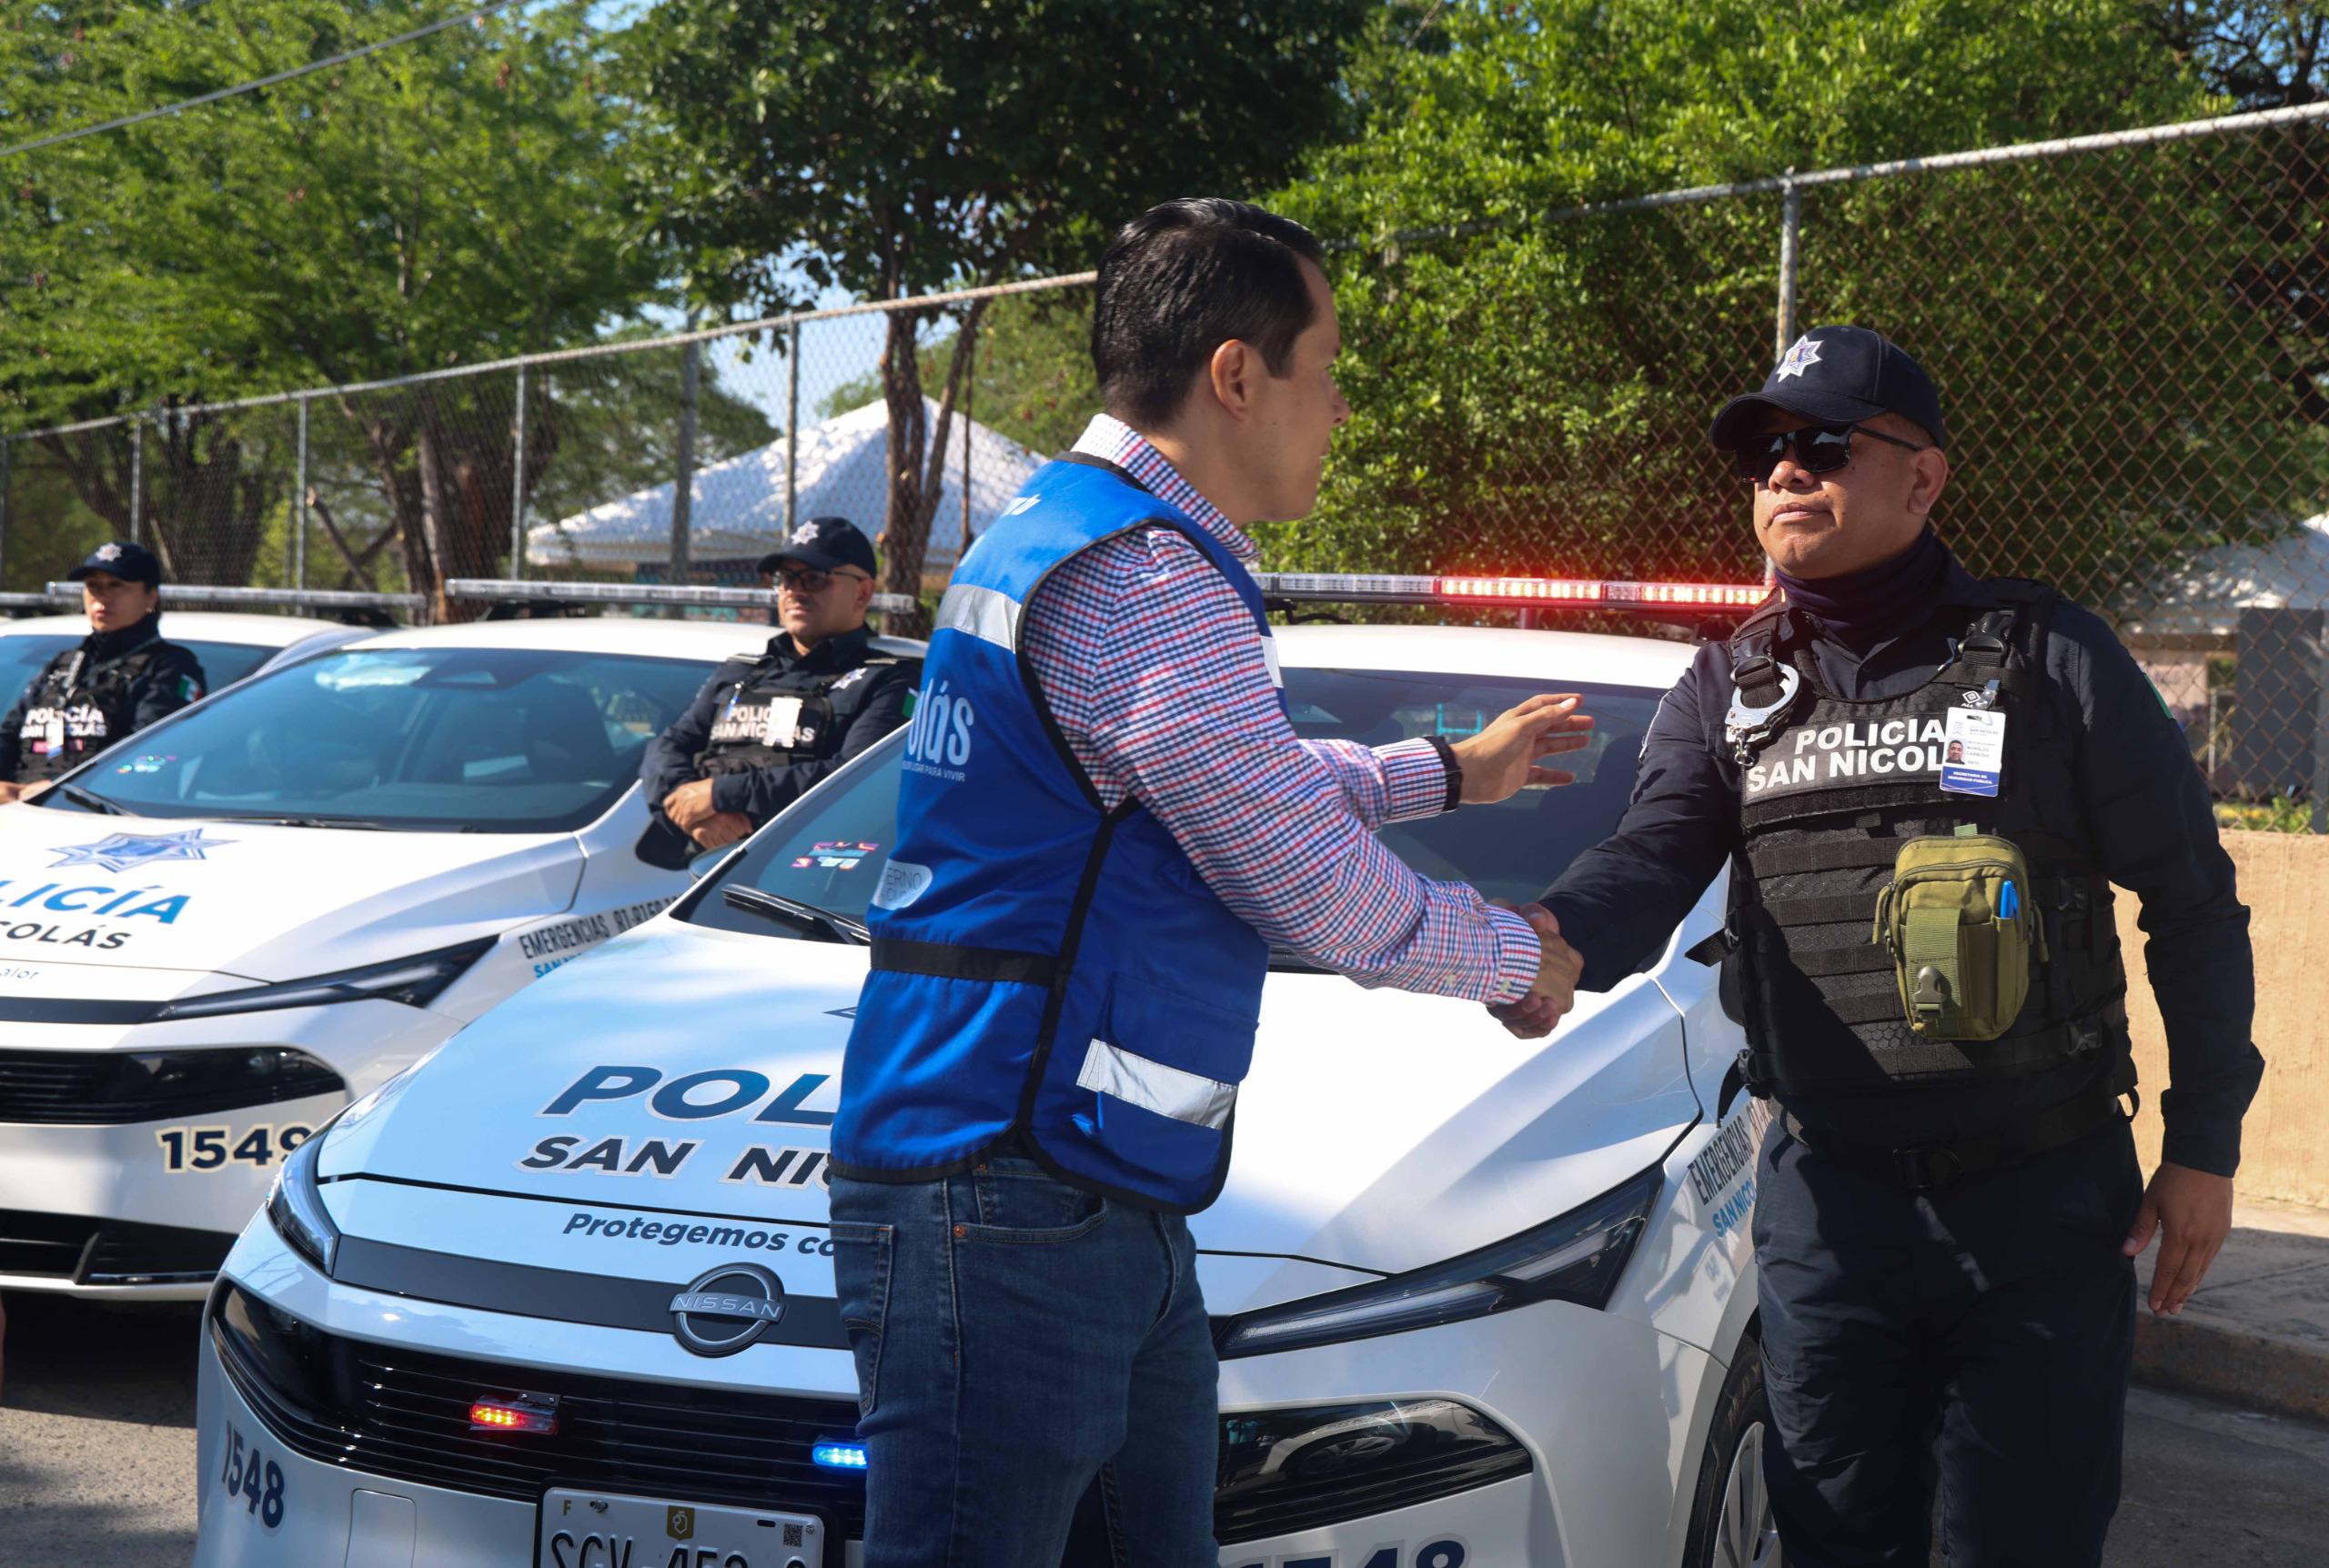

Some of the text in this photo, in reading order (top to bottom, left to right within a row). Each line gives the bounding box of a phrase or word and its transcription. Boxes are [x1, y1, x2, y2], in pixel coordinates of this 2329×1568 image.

[1795, 719, 1946, 755] POLICIA
[1748, 745, 1945, 793] SAN NICOL
[518, 914, 610, 960] EMERGENCIAS
[519, 1135, 698, 1175] SAN
[1688, 1115, 1756, 1206] EMERGENCIAS
[563, 1212, 790, 1250] Protegemos
[1712, 1201, 1739, 1238] SAN
[671, 1293, 781, 1319] NISSAN
[222, 1420, 285, 1529] 1548
